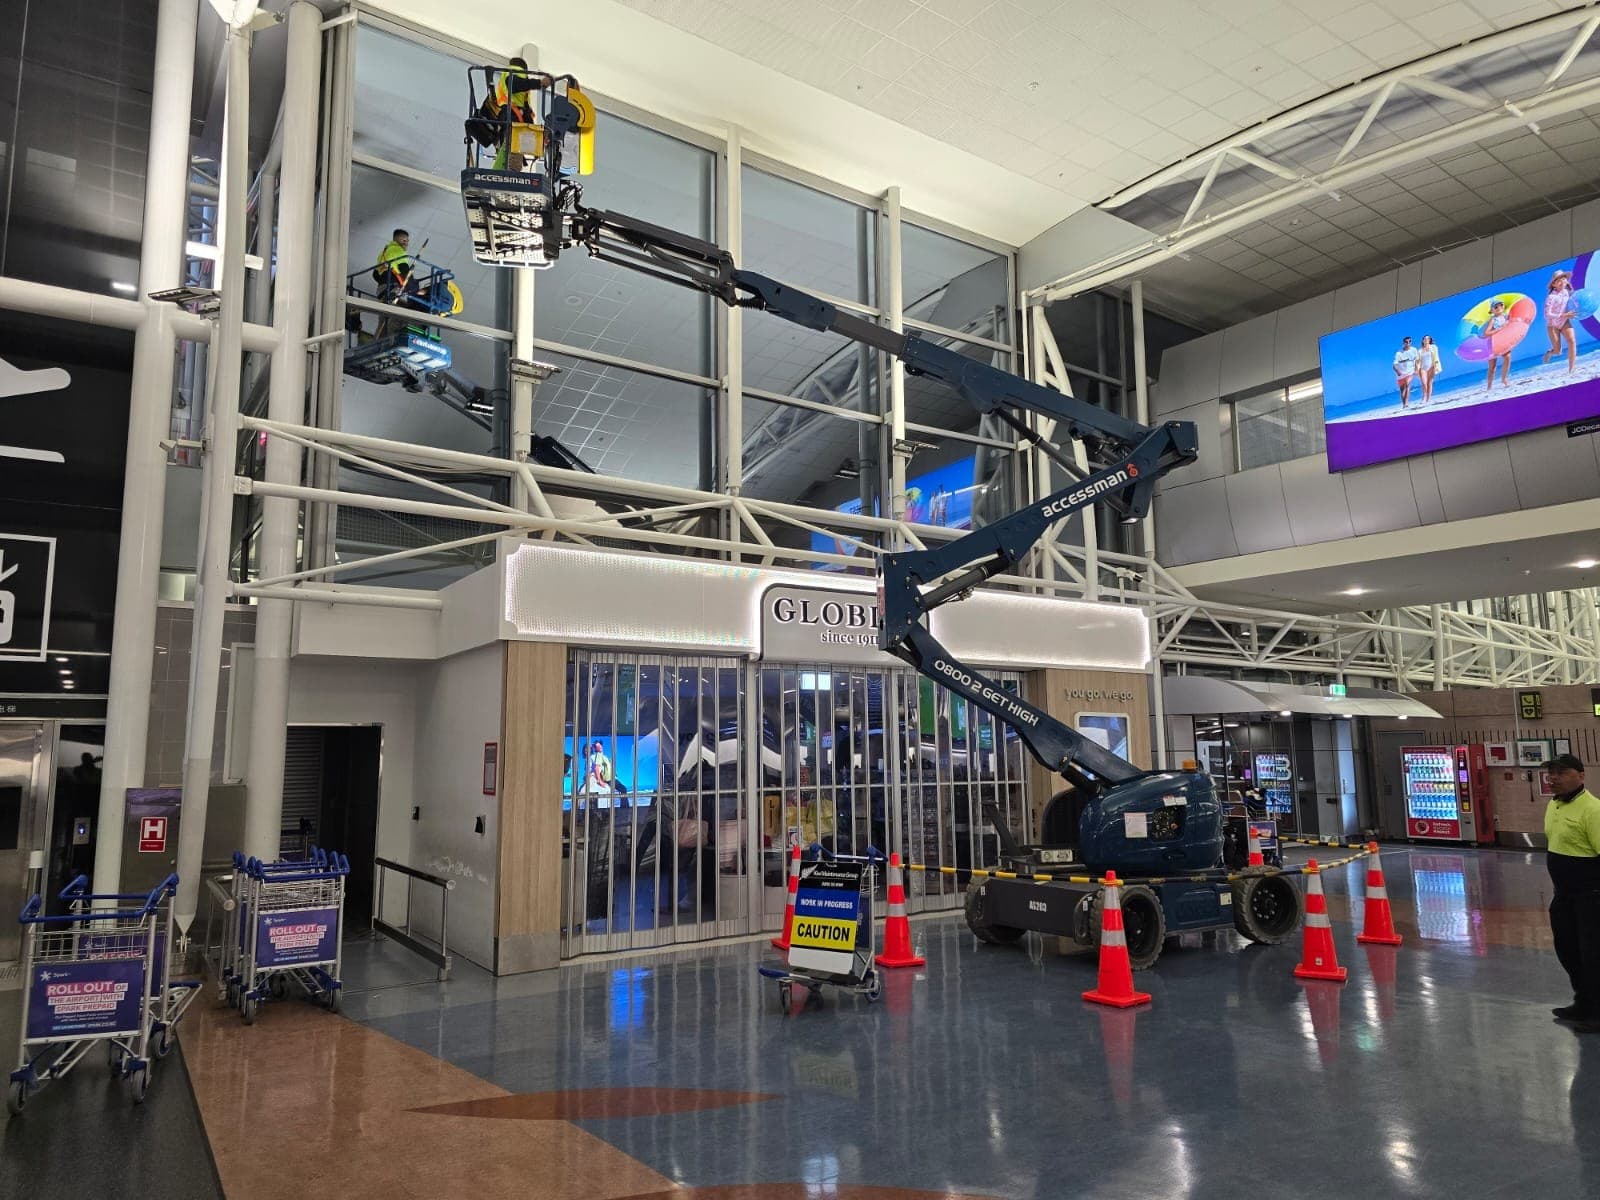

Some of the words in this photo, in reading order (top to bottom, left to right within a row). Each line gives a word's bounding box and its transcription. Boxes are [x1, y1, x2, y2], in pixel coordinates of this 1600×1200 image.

[474, 173, 531, 185] accessman
[1571, 424, 1600, 434] JCDeca
[1041, 470, 1128, 518] accessman
[772, 597, 878, 628] GLOBI
[821, 630, 855, 644] since
[934, 660, 972, 686] 0800
[971, 680, 982, 693] 2
[982, 687, 1009, 707] GET
[1007, 701, 1039, 727] HIGH
[1065, 688, 1085, 702] you
[143, 820, 164, 839] H
[270, 926, 294, 936] ROLL
[295, 924, 317, 933] OUT
[797, 923, 850, 942] CAUTION
[47, 984, 81, 996] ROLL
[83, 981, 113, 993] OUT
[66, 994, 100, 1002] AIRPORT
[83, 1003, 114, 1011] PREPAID
